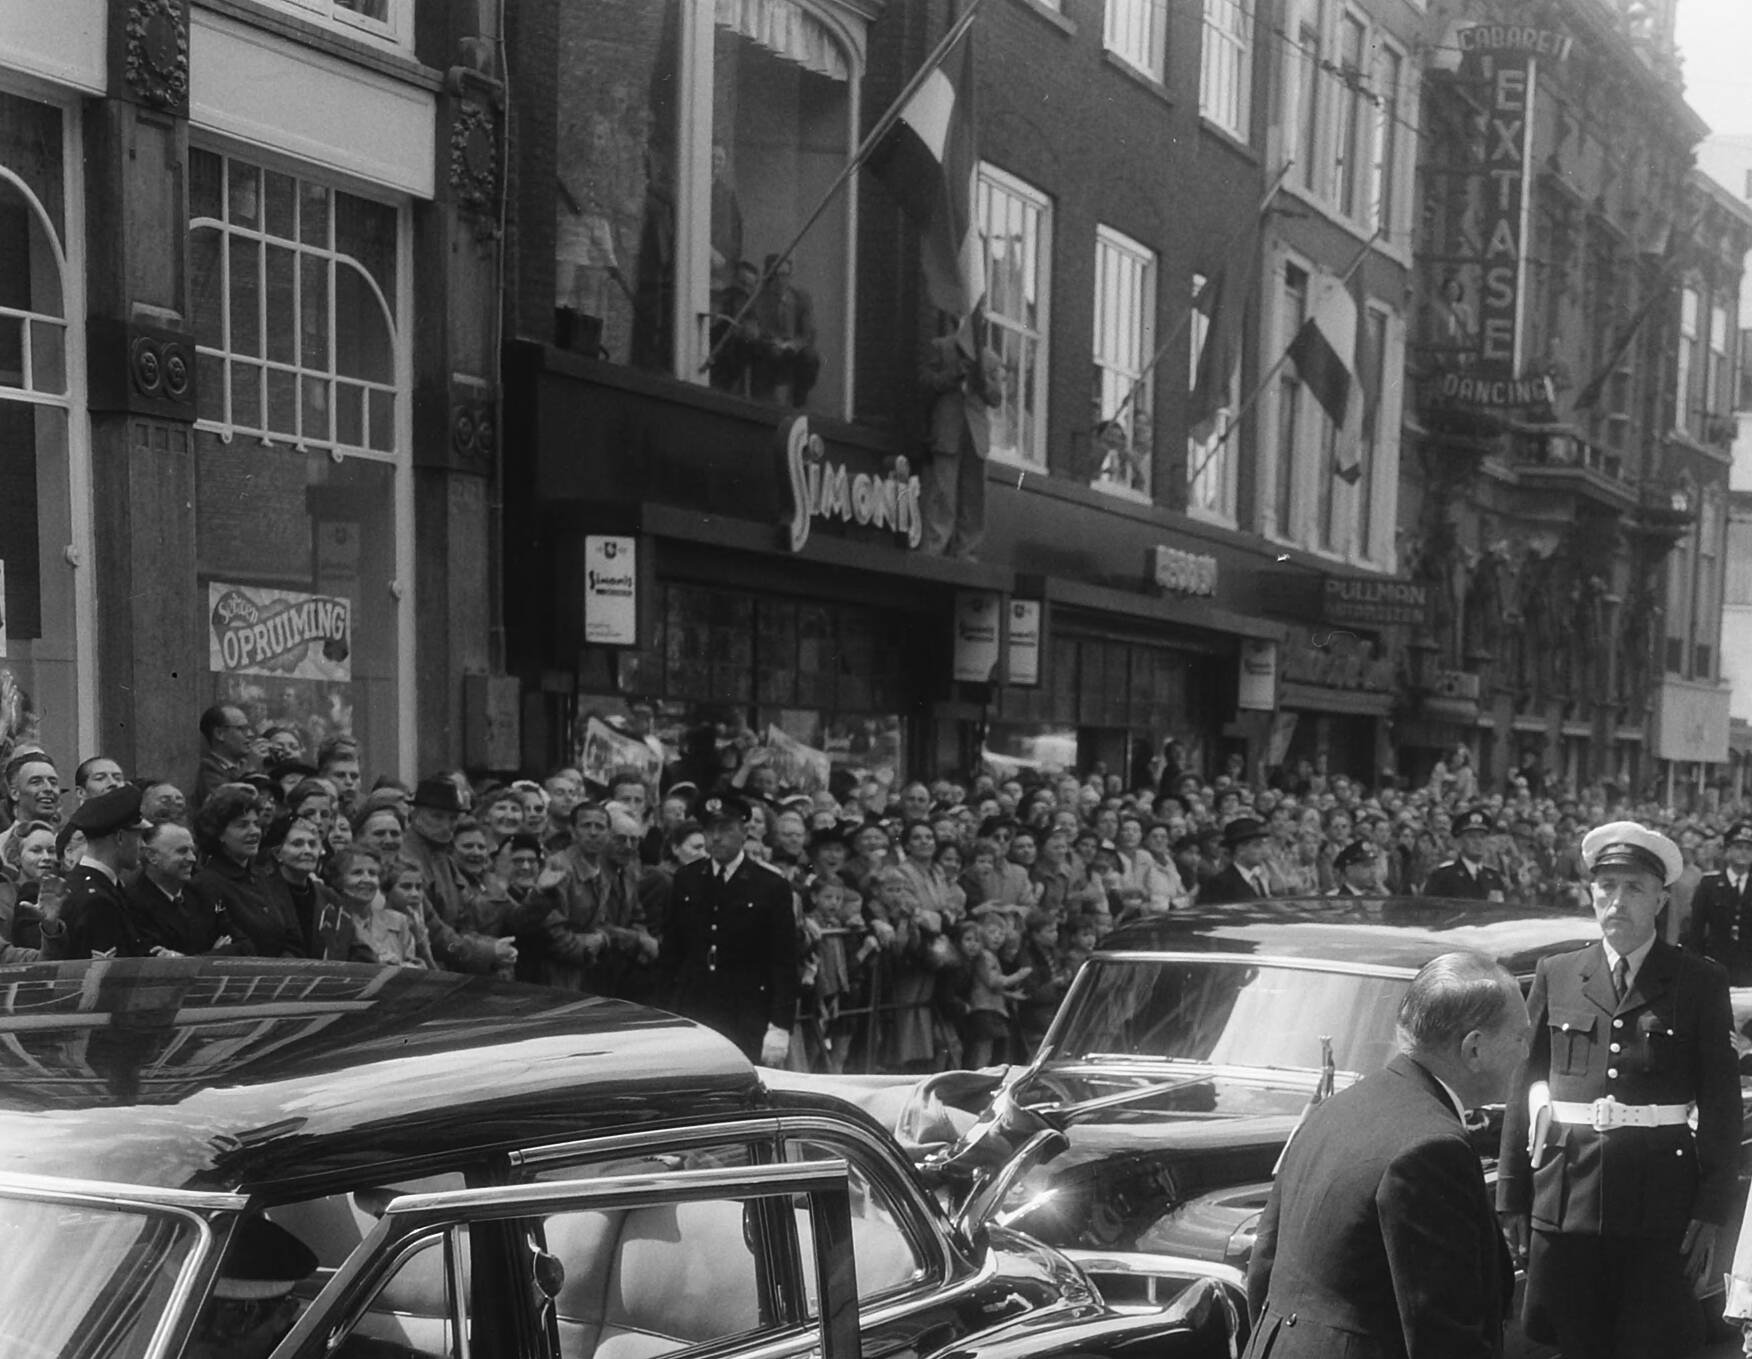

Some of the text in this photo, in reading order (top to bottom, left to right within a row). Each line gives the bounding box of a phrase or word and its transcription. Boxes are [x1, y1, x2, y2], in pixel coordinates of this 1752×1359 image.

[1483, 69, 1526, 360] EXTASE
[1443, 373, 1547, 403] DANCING
[223, 601, 346, 668] OPRUIMING
